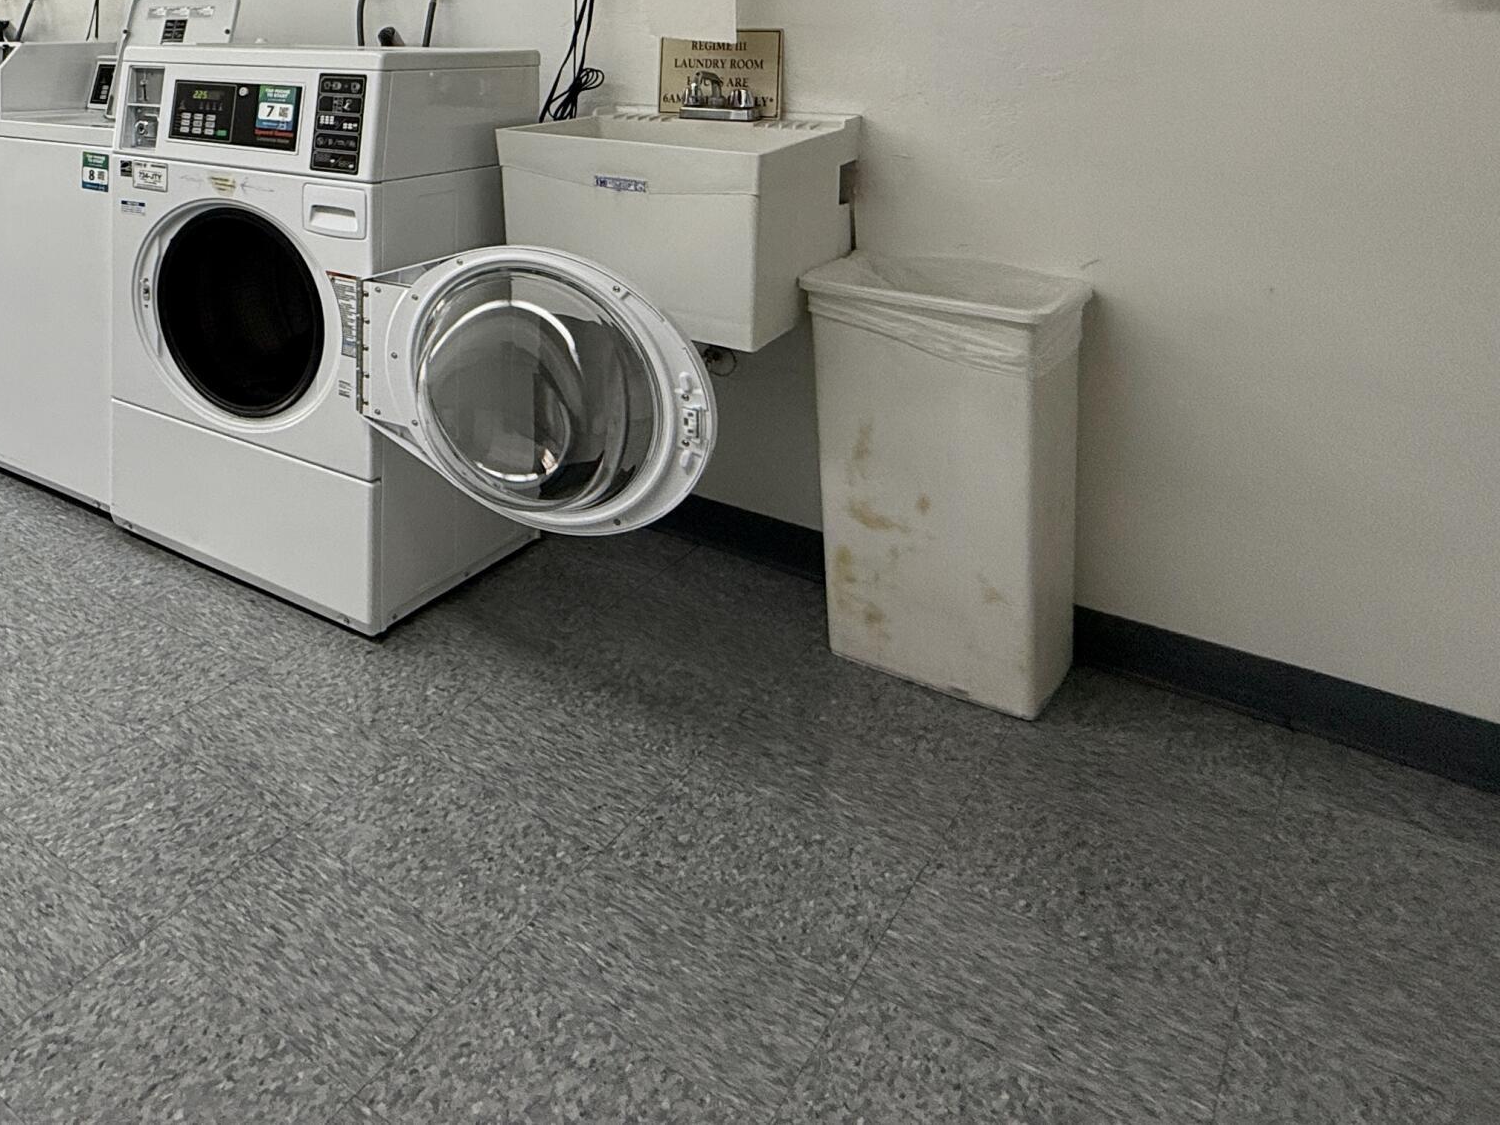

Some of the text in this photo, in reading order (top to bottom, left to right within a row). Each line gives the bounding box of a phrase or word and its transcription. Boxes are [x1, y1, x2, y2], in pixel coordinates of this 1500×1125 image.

[691, 40, 733, 52] REGIME
[674, 58, 764, 70] LAUNDRY ROOM
[726, 76, 749, 88] ARE
[266, 105, 275, 118] 7
[88, 169, 95, 181] 8
